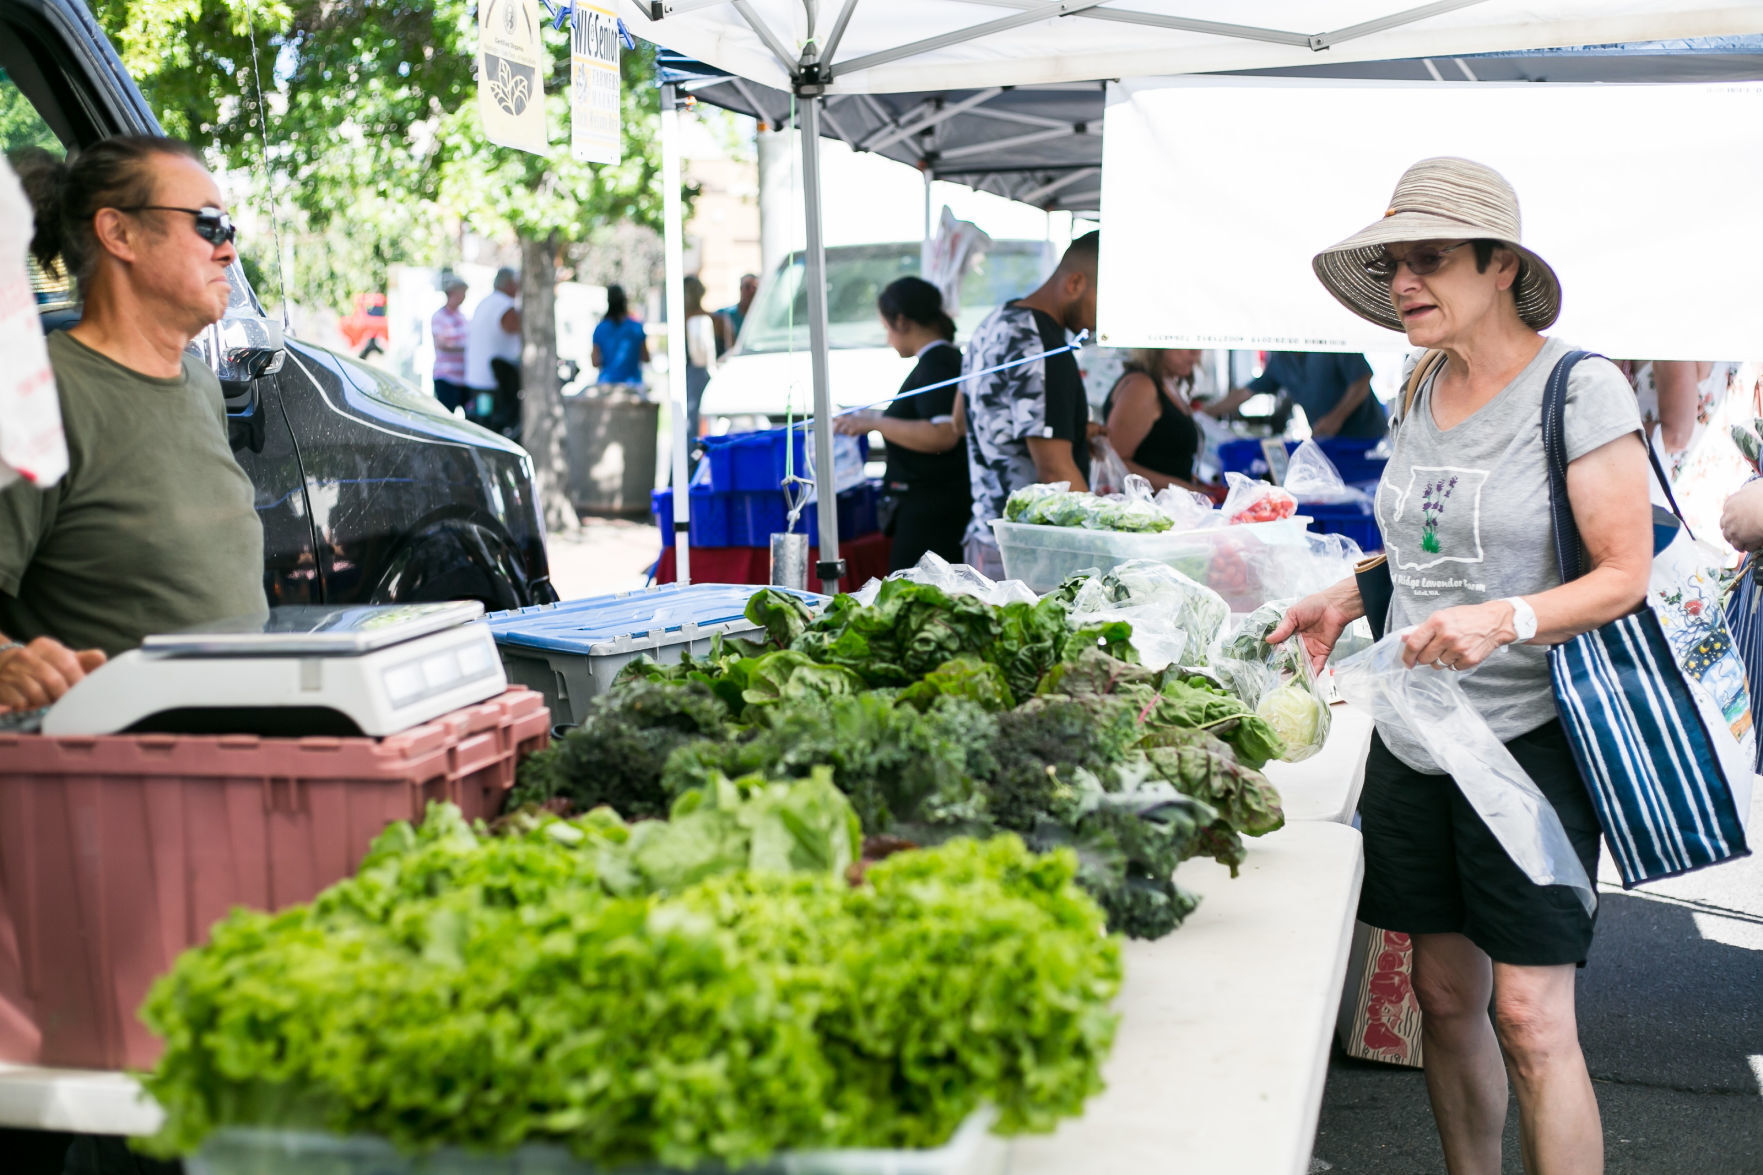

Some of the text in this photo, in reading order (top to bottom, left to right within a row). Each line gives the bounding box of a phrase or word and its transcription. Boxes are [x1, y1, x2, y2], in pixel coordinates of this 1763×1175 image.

[574, 9, 592, 56] WIC
[594, 13, 618, 64] Senior
[1398, 575, 1420, 589] Ridge
[1421, 577, 1463, 588] Lavender
